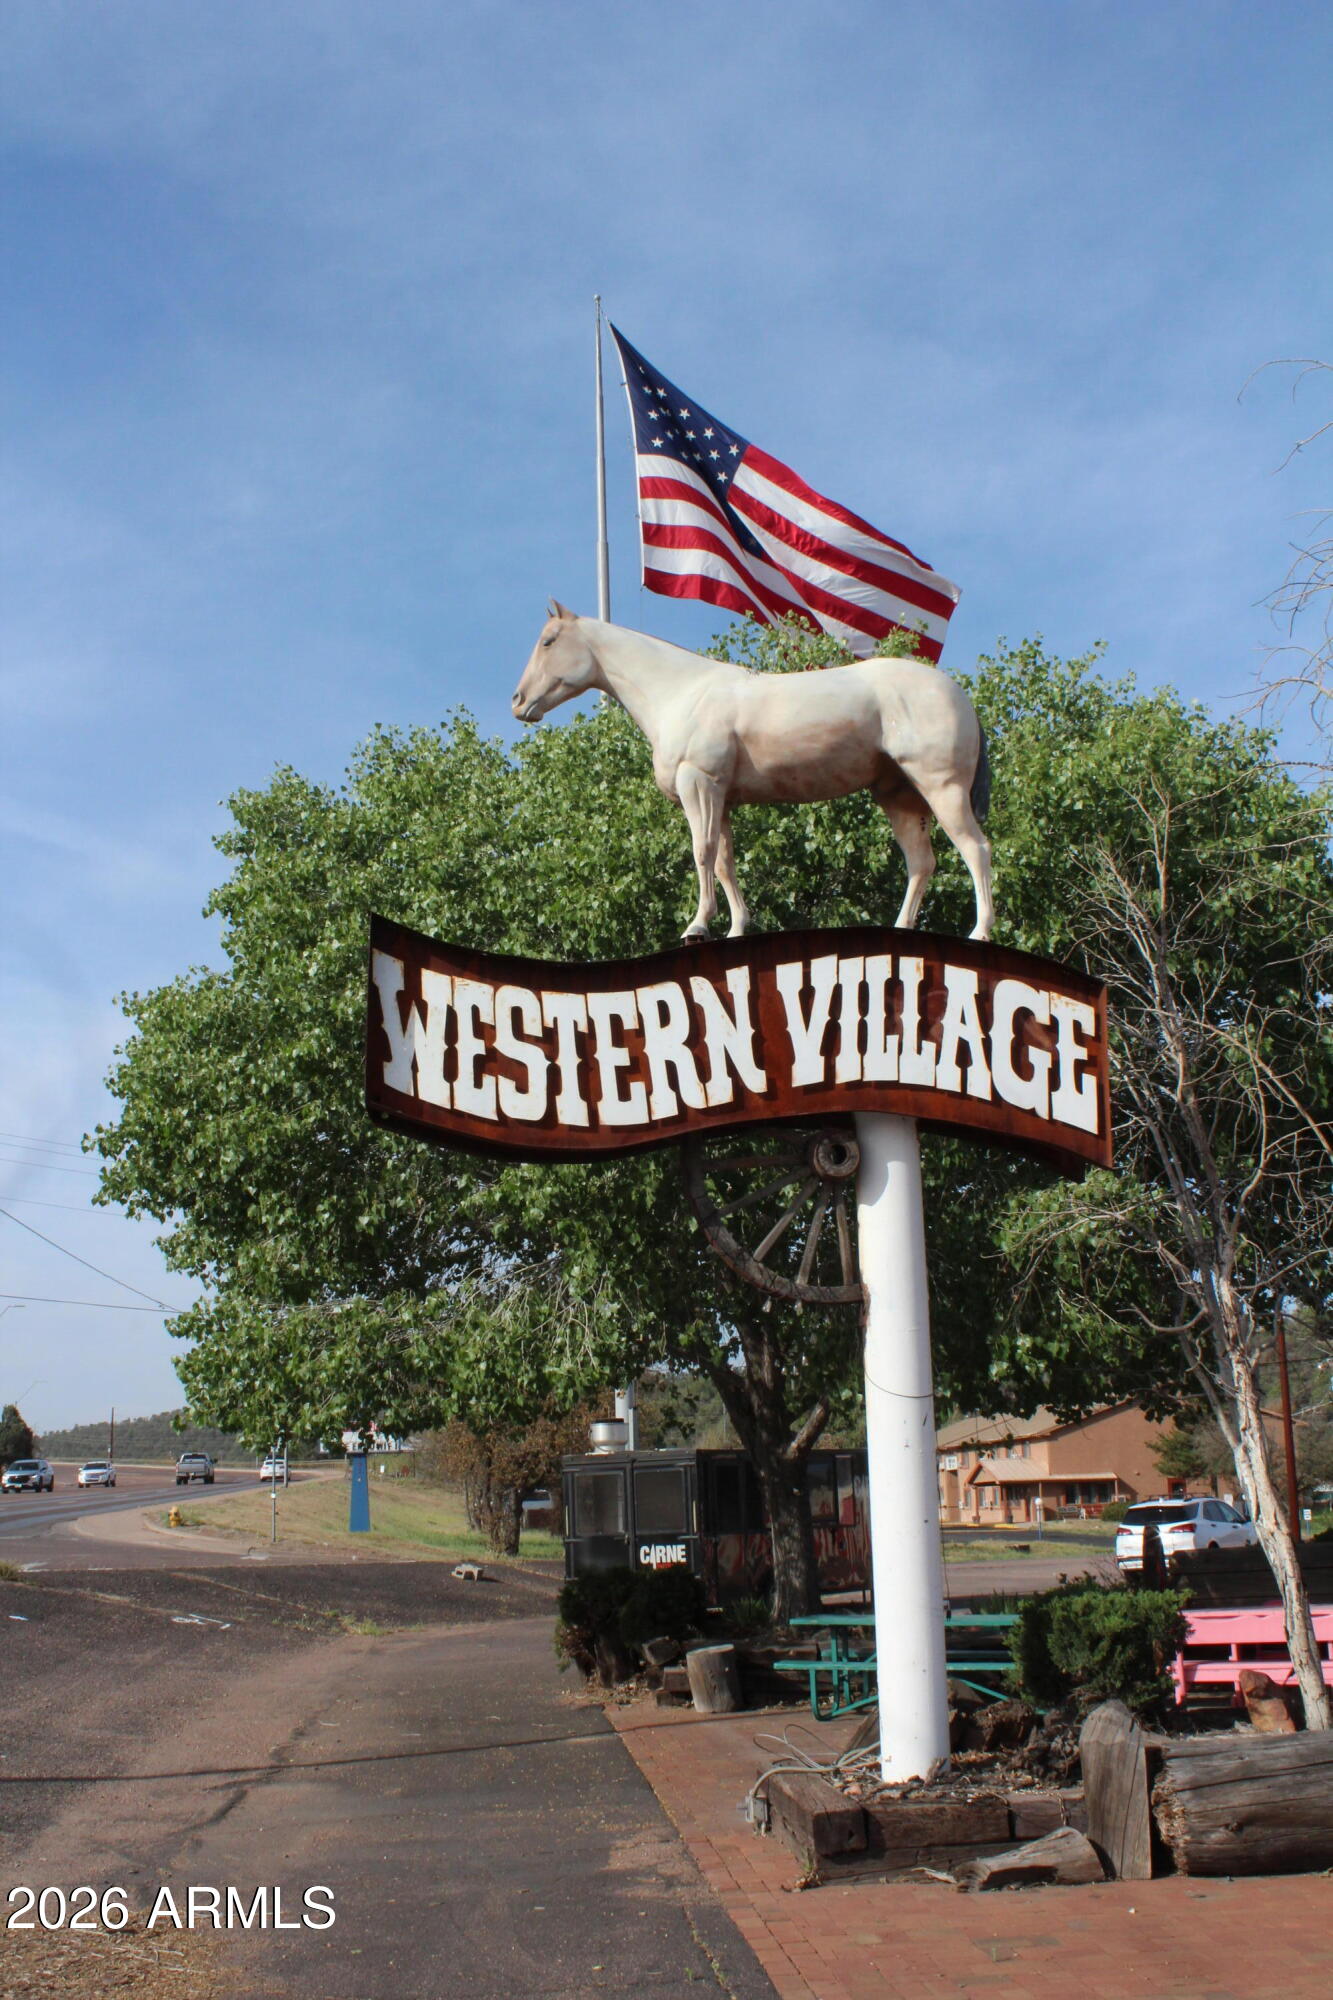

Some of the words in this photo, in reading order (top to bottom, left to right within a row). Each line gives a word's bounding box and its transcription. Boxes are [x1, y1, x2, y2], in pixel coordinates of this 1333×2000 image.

[371, 949, 767, 1127] WESTERN
[775, 953, 1099, 1134] VILLAGE
[640, 1544, 687, 1569] CARNE
